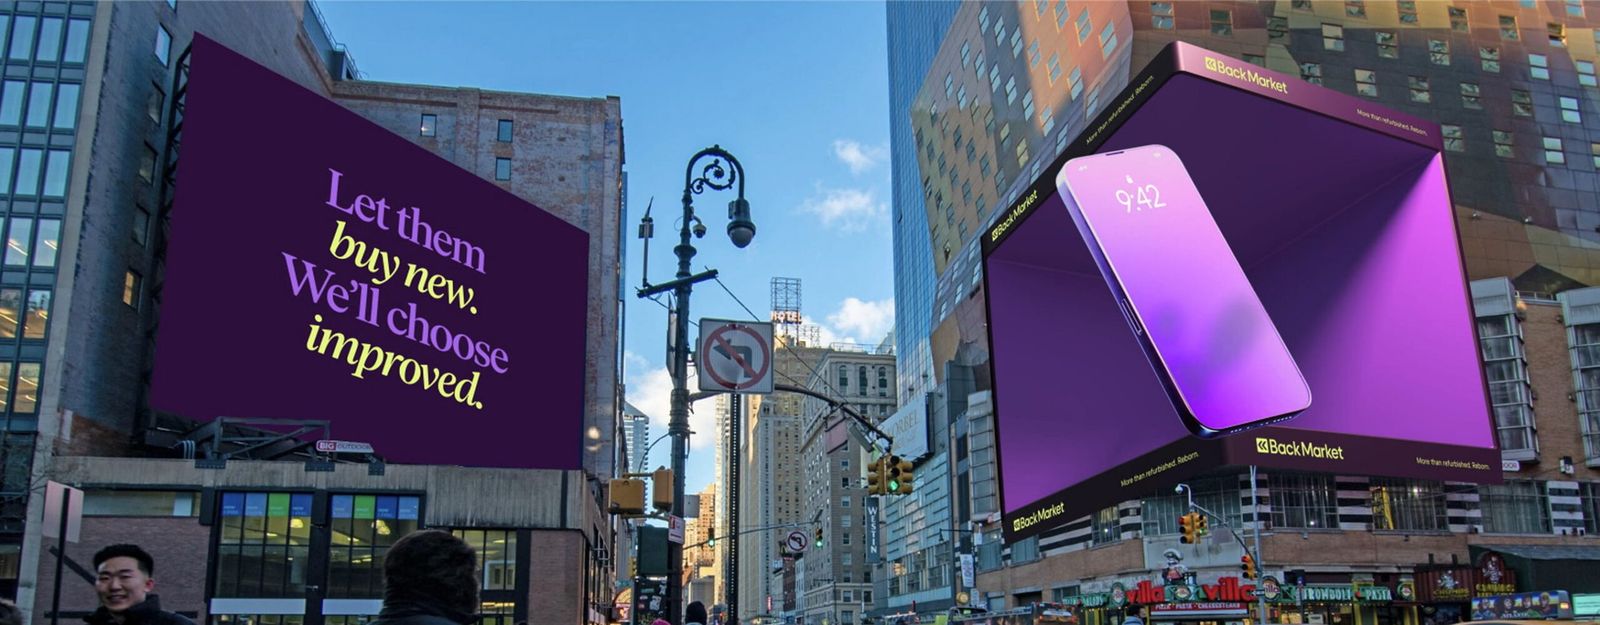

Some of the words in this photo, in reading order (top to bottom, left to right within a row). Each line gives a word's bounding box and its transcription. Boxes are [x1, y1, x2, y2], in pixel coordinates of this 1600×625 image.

[1217, 61, 1247, 81] Back
[1247, 70, 1289, 95] Market
[997, 212, 1014, 236] Back
[1013, 190, 1038, 220] Market
[1115, 184, 1167, 213] 9:42
[325, 167, 390, 230] Let
[396, 207, 486, 274] them
[329, 220, 400, 285] buy
[404, 263, 478, 314] new.
[770, 310, 802, 322] HOTEL
[387, 302, 509, 374] choose
[306, 314, 483, 410] improved.
[319, 441, 335, 450] BIG
[1269, 439, 1301, 456] Back
[1301, 442, 1344, 460] Market
[1416, 457, 1430, 465] More
[1120, 477, 1134, 488] More
[1133, 470, 1146, 483] than
[1177, 451, 1200, 465] Reborn.
[867, 506, 878, 554] WESTIN
[1020, 511, 1037, 528] Back
[1037, 502, 1065, 522] Market
[1125, 580, 1165, 603] villa
